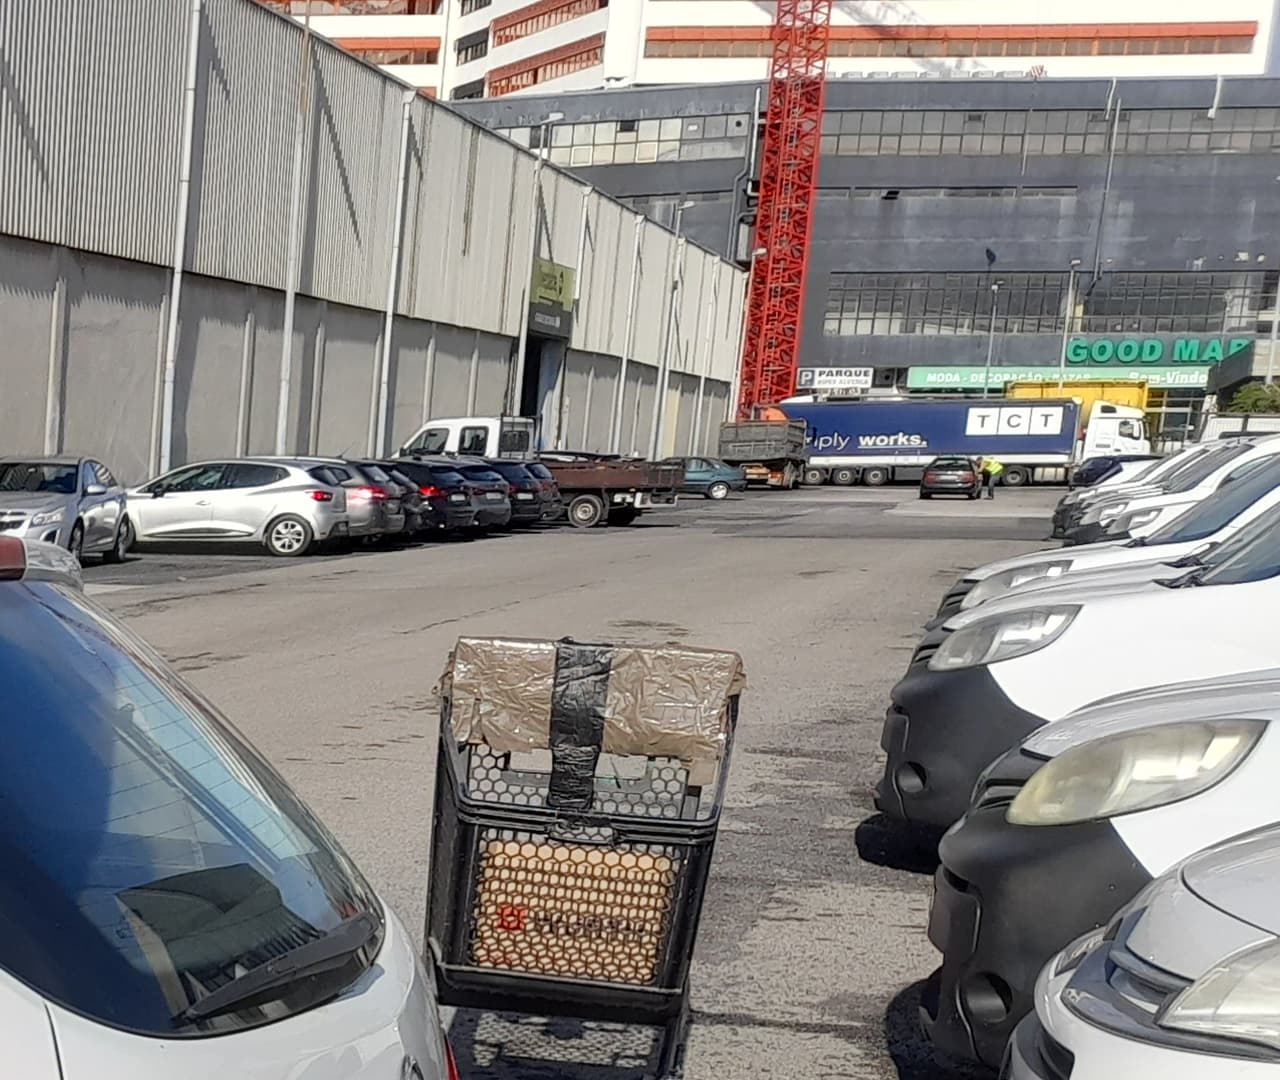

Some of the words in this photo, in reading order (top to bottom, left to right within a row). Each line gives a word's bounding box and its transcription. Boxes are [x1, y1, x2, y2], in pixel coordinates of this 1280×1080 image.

[1066, 338, 1163, 363] GOOD
[818, 369, 871, 378] PARQUE
[926, 372, 960, 383] MODA
[858, 431, 928, 447] works.
